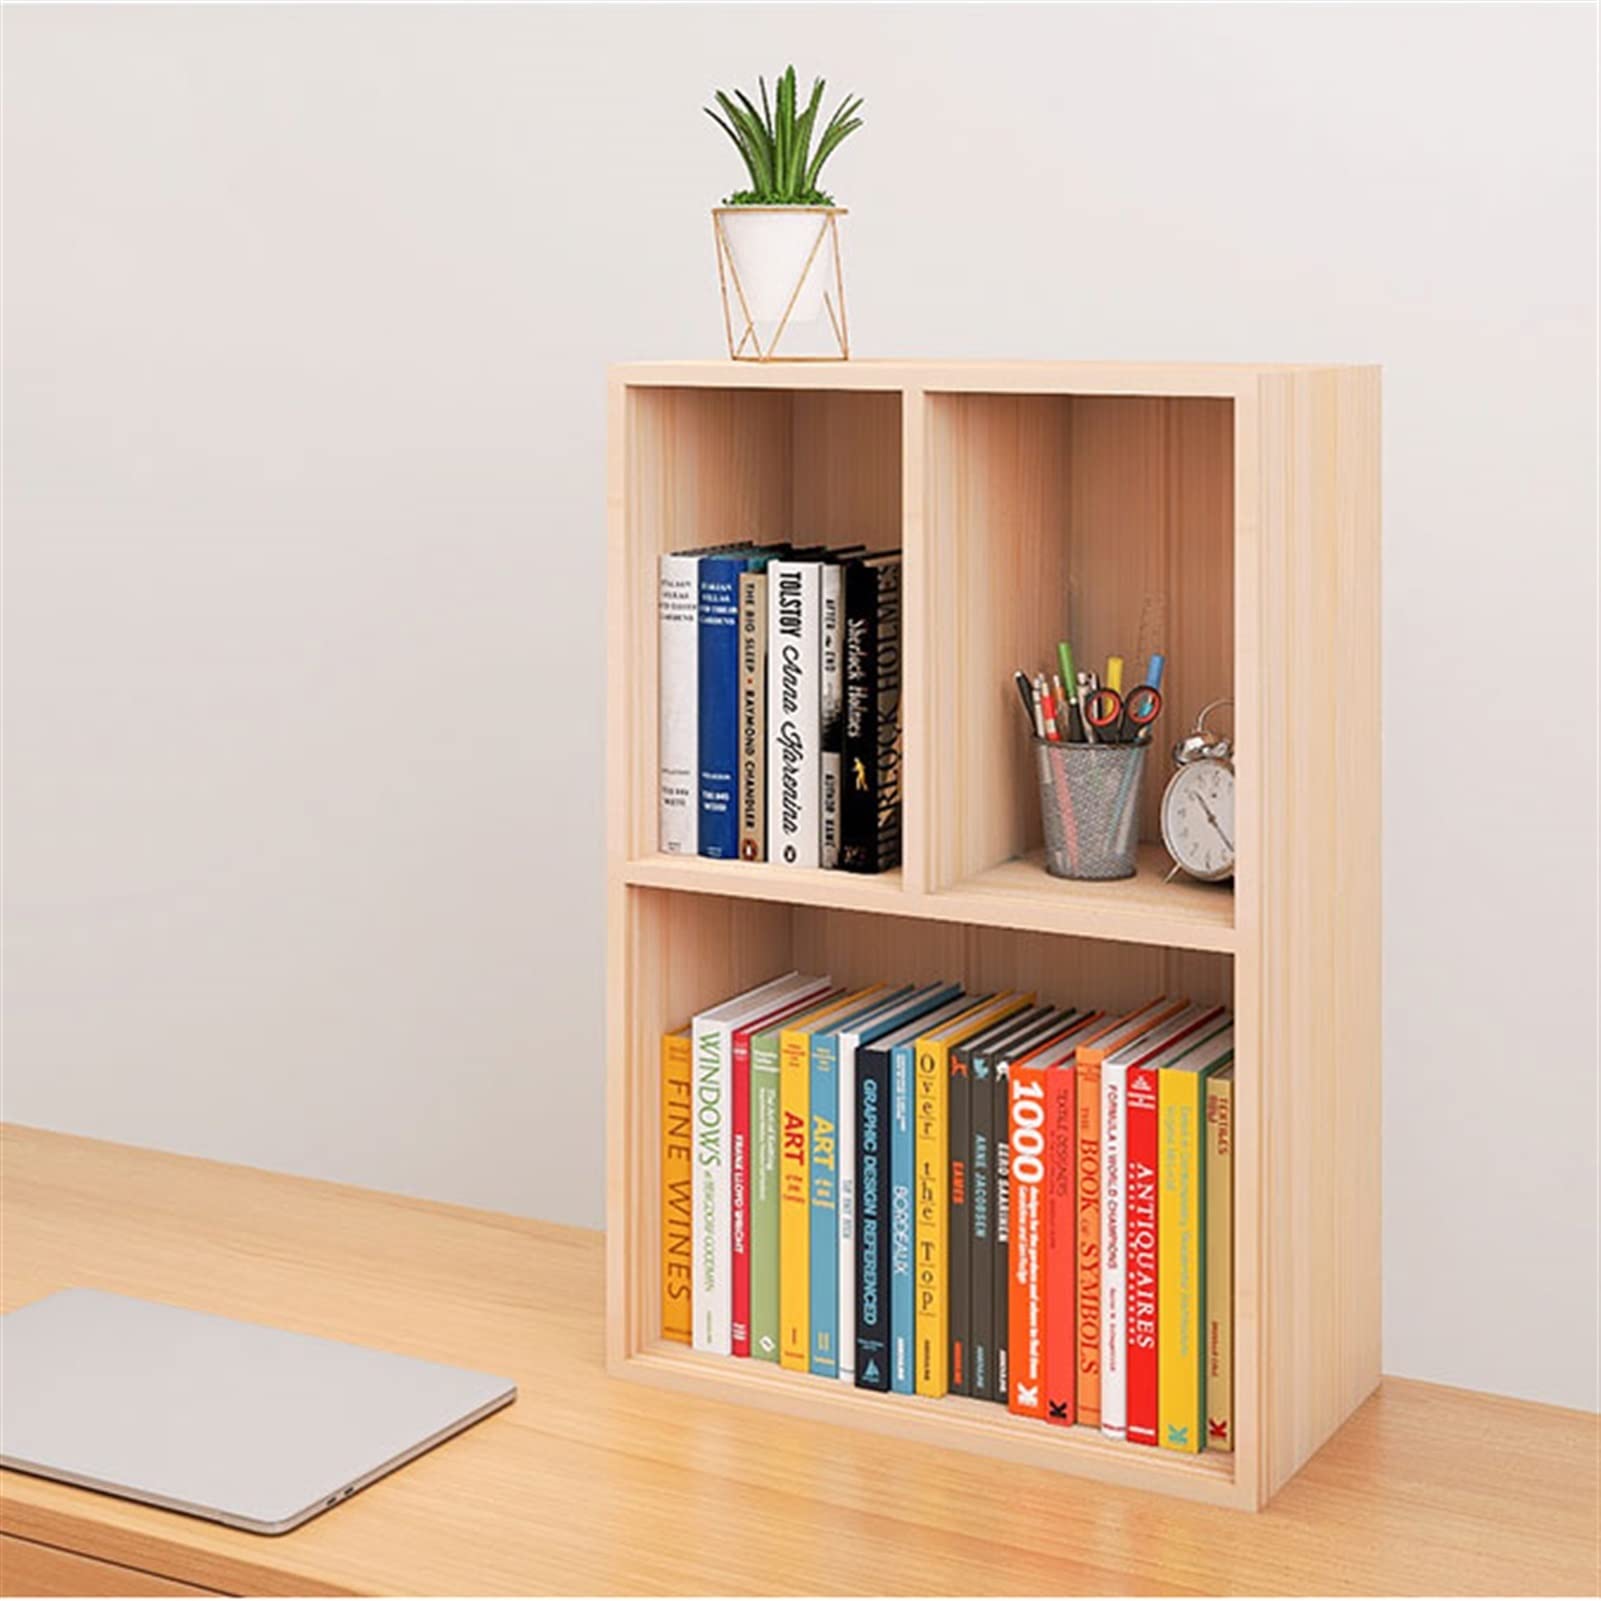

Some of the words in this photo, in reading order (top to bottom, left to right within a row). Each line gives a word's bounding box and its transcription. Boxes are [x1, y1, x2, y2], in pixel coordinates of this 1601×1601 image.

[744, 583, 756, 605] THE
[744, 611, 756, 632] BIG
[779, 572, 802, 638] TOLSTOY
[744, 637, 756, 673] SLEEP
[782, 645, 804, 716] Anna
[847, 618, 869, 680] Sherlock
[744, 689, 756, 757] RAYMOND
[847, 684, 869, 739] Holmes
[744, 761, 756, 829] CHANDLER
[776, 720, 804, 836] Karenina
[667, 1079, 692, 1161] FINE
[698, 1031, 722, 1167] WINDOWS
[863, 1079, 877, 1151] GRAPHIC
[1012, 1079, 1045, 1184] 1000
[1107, 1084, 1119, 1141] FORMULA
[784, 1111, 805, 1166] ART
[812, 1115, 835, 1171] ART
[863, 1154, 877, 1216] DESIGN
[1080, 1138, 1099, 1212] BOOK
[667, 1179, 692, 1302] WINES
[893, 1186, 908, 1276] BORDEAUX
[1135, 1162, 1155, 1349] ANTIQUAIRES
[863, 1219, 877, 1325] REFERENCED
[1079, 1241, 1100, 1375] SYMBOLS
